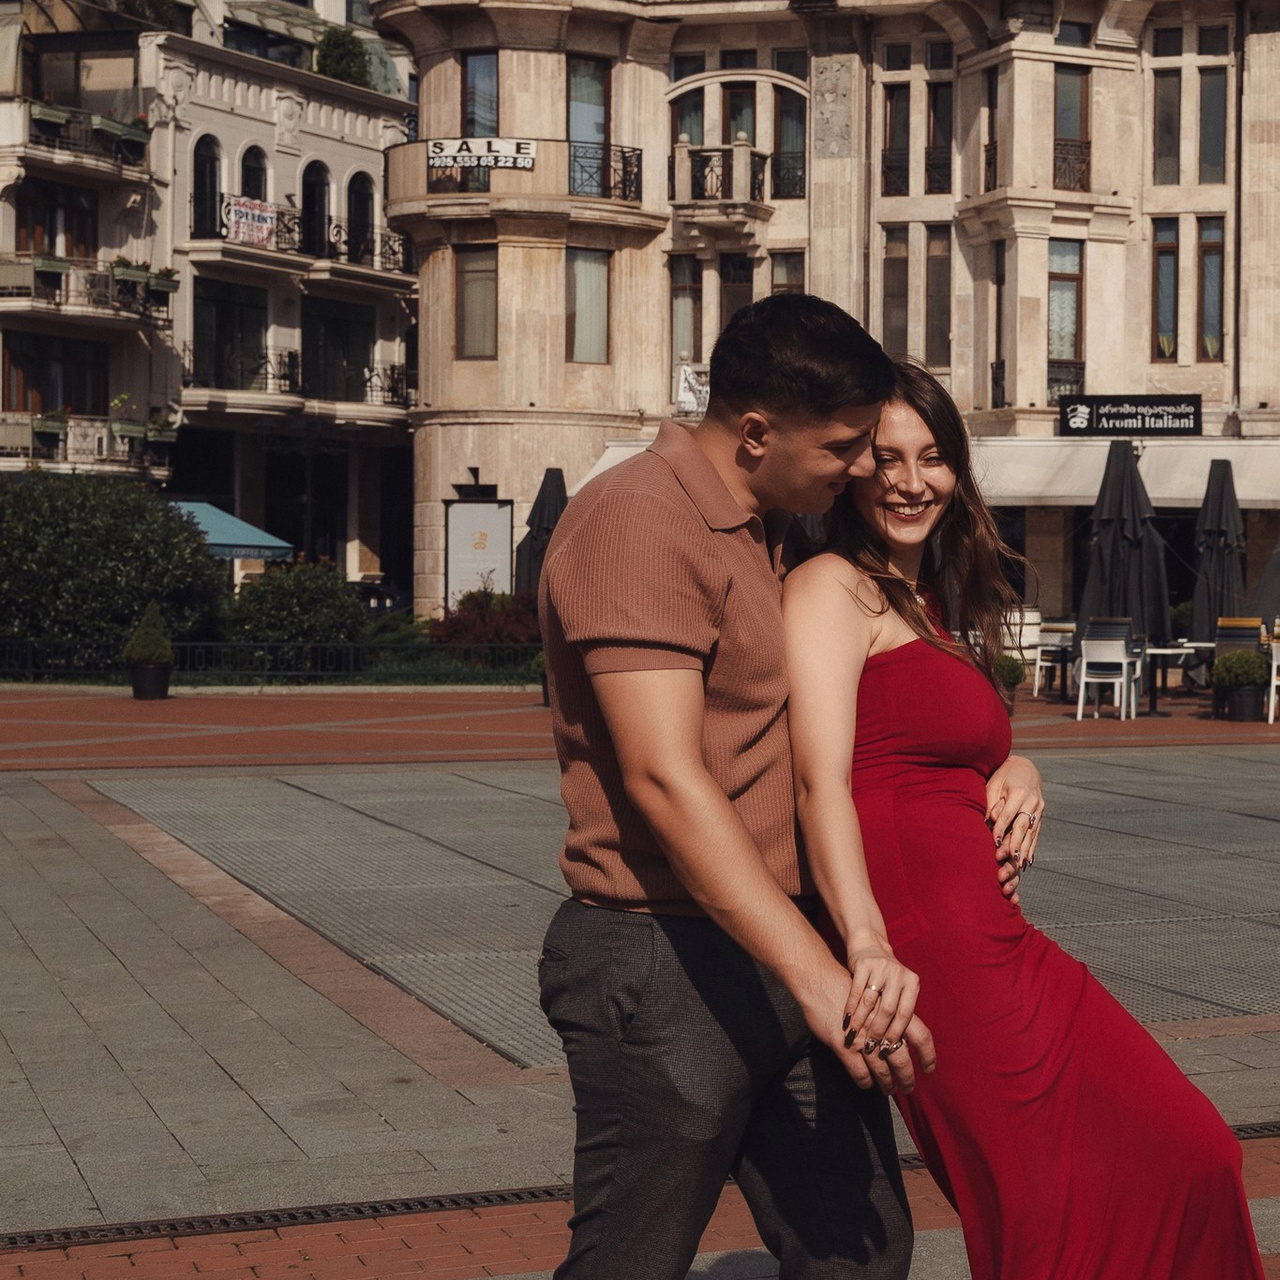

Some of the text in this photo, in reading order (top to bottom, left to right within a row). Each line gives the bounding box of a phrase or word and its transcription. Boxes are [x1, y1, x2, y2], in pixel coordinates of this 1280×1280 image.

[432, 141, 531, 155] SALE
[456, 156, 478, 167] 555
[480, 156, 495, 167] 05
[497, 157, 514, 167] 22
[516, 158, 533, 168] 50
[1098, 415, 1195, 429] Aromi Italiani
